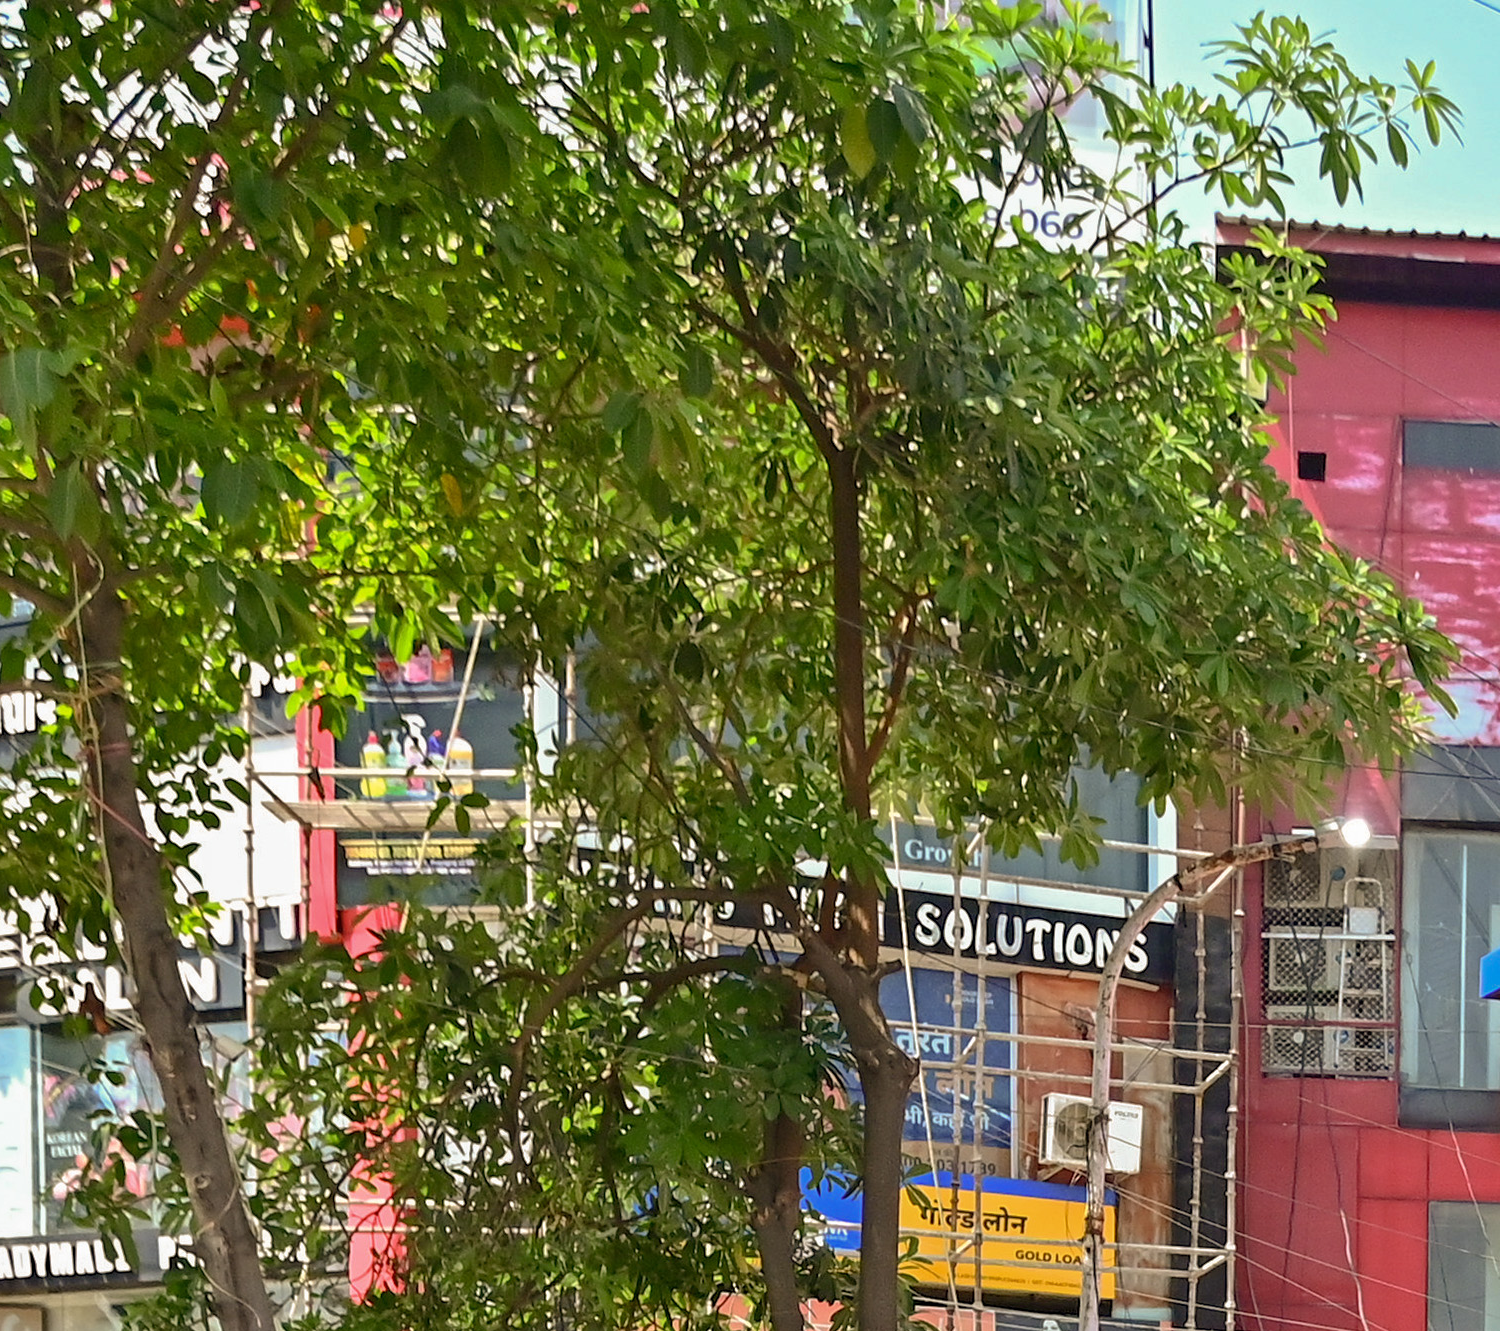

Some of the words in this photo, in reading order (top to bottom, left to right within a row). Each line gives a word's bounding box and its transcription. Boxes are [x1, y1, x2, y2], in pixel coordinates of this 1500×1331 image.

[915, 902, 1149, 974] SOLUTIONS
[982, 1206, 1029, 1234] लोन
[1014, 1248, 1052, 1264] GOLD
[1054, 1250, 1083, 1266] LOA
